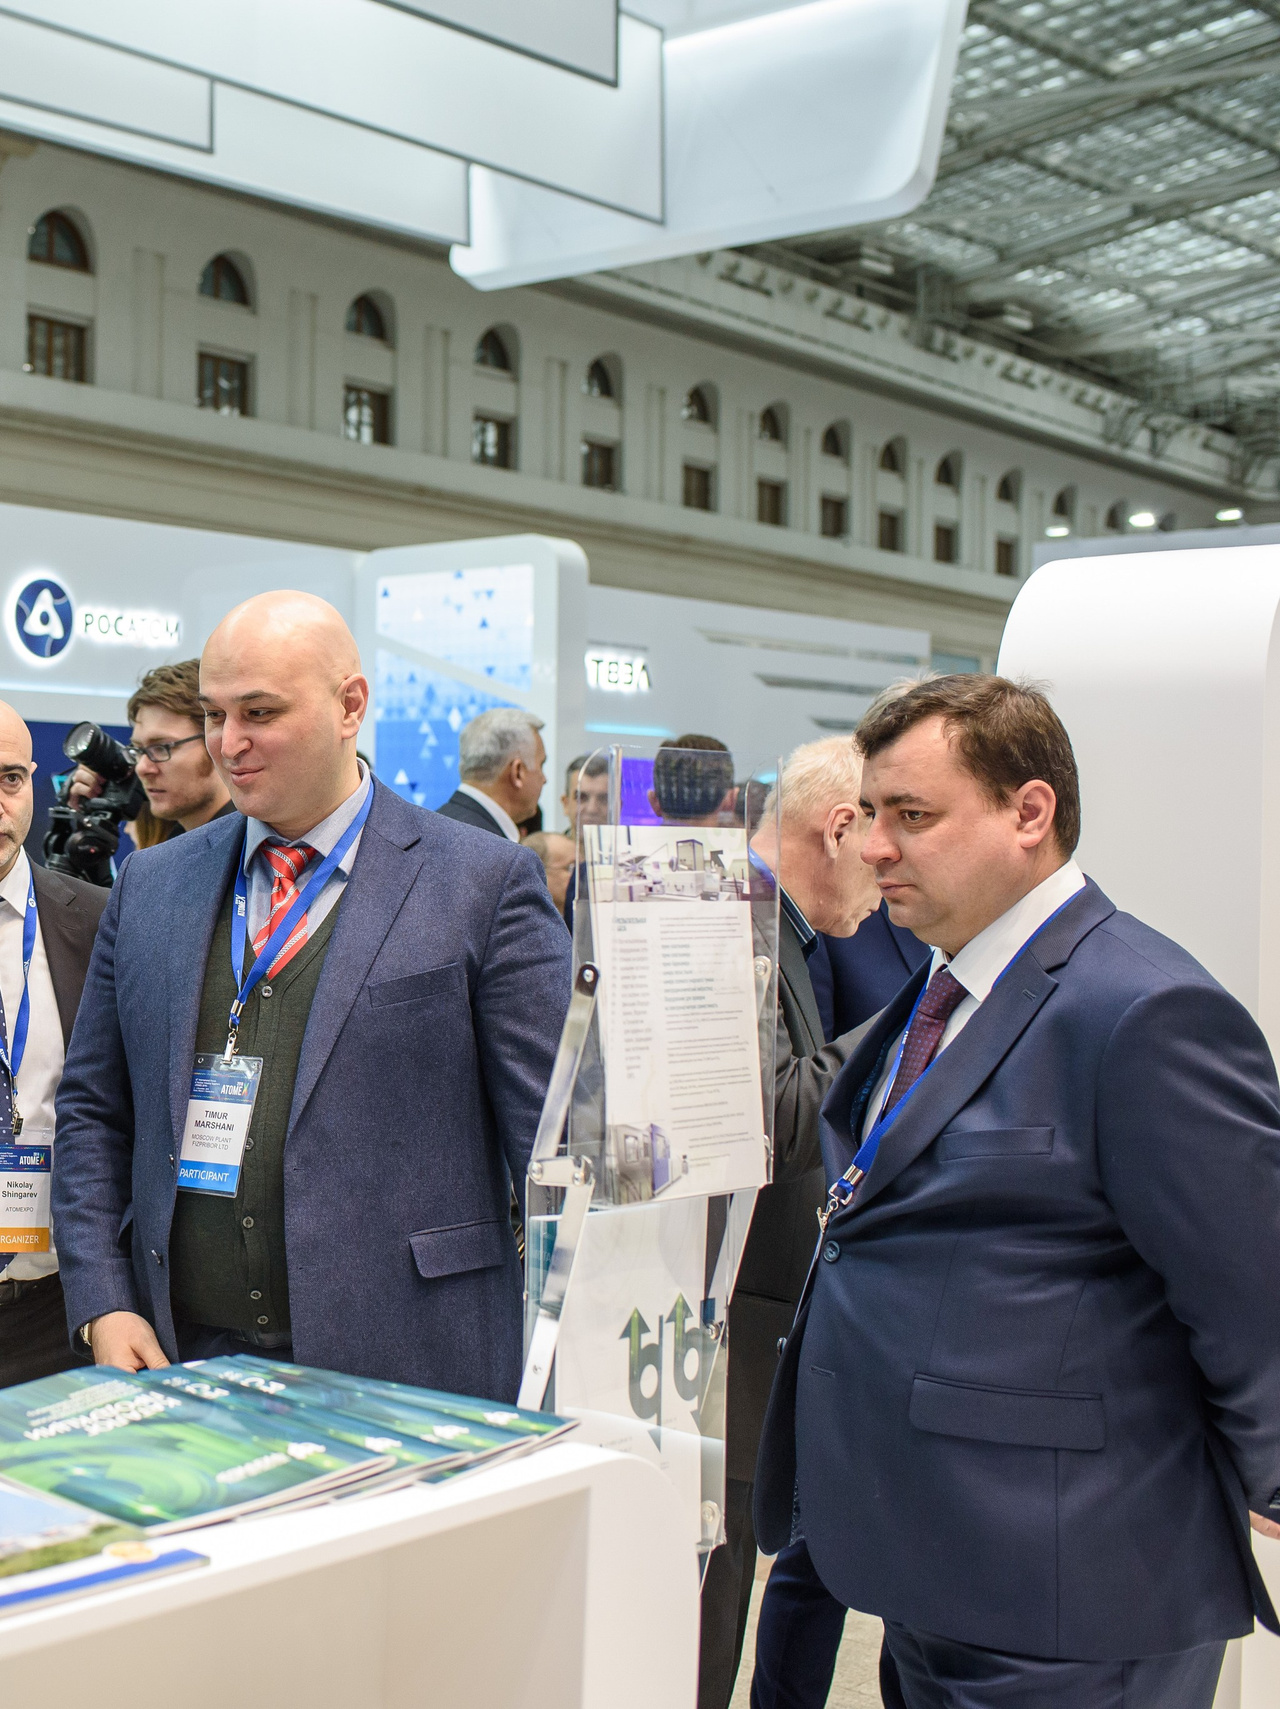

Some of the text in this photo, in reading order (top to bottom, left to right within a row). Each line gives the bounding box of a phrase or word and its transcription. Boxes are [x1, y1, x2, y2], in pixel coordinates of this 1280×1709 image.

[220, 1082, 250, 1097] ATOMEX
[204, 1110, 228, 1121] TIMUR
[194, 1120, 235, 1132] MARSHANI
[191, 1133, 232, 1144] MOSCOW PLANT
[218, 1142, 229, 1151] LTD
[19, 1152, 46, 1166] ATOMEX
[179, 1167, 230, 1182] PARTICIPANT
[6, 1181, 33, 1190] Nikolay
[1, 1191, 38, 1200] Shingarev
